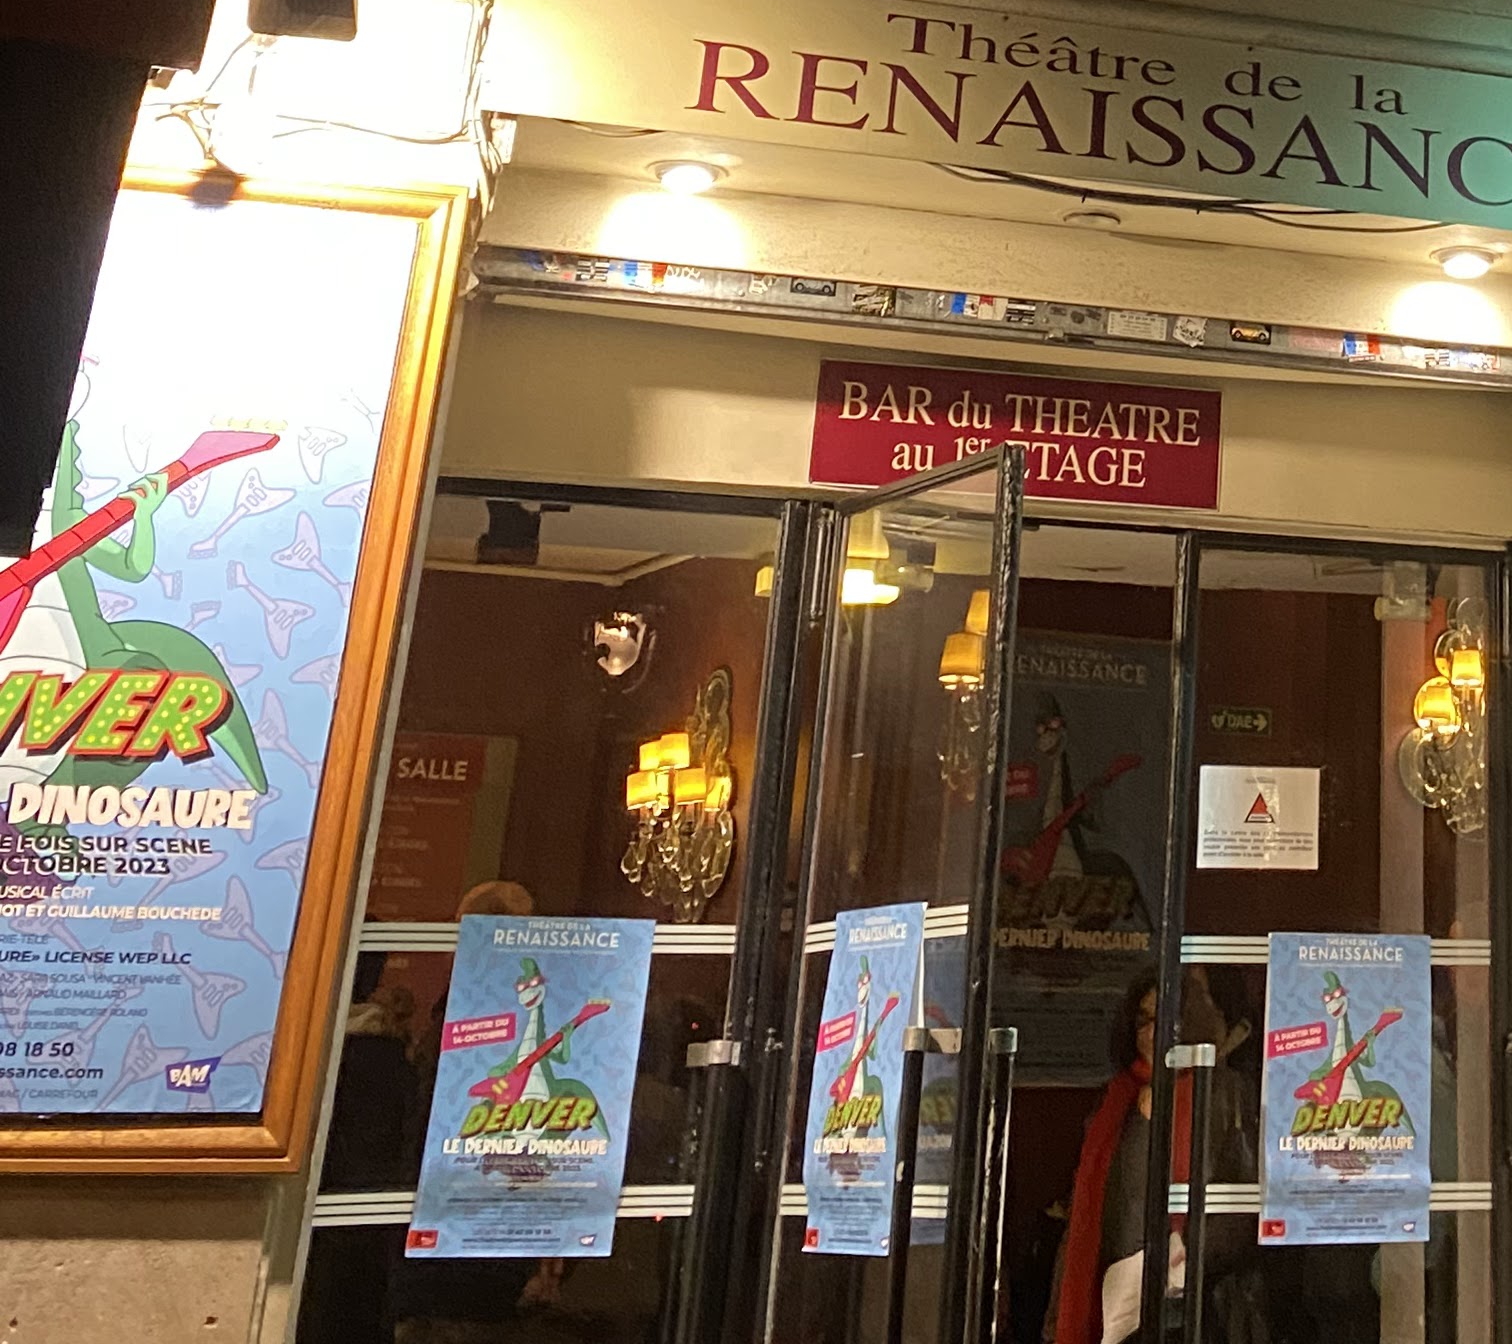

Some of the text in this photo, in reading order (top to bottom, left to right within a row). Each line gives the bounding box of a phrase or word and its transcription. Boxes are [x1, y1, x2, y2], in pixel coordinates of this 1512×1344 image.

[886, 12, 1407, 116] Théâtre de la
[838, 380, 1200, 448] BAR du THEATRE
[891, 442, 935, 472] au
[397, 757, 468, 782] SALLE
[8, 782, 257, 830] DINOSAURE
[80, 836, 128, 855] SUR
[114, 857, 171, 876] 2023
[47, 905, 135, 920] GUILLAUME
[136, 906, 222, 921] BOUCHEDE
[493, 928, 621, 949] RENAISSANCE
[45, 951, 192, 965] LICENSE WEP LLC
[1298, 945, 1404, 963] RENAISSANCE
[24, 1042, 74, 1058] 18 50
[458, 1096, 602, 1140] DENVER
[822, 1093, 884, 1136] DENVER
[1291, 1096, 1404, 1138] DENVER
[442, 1138, 461, 1155] LE
[1279, 1135, 1294, 1152] LE
